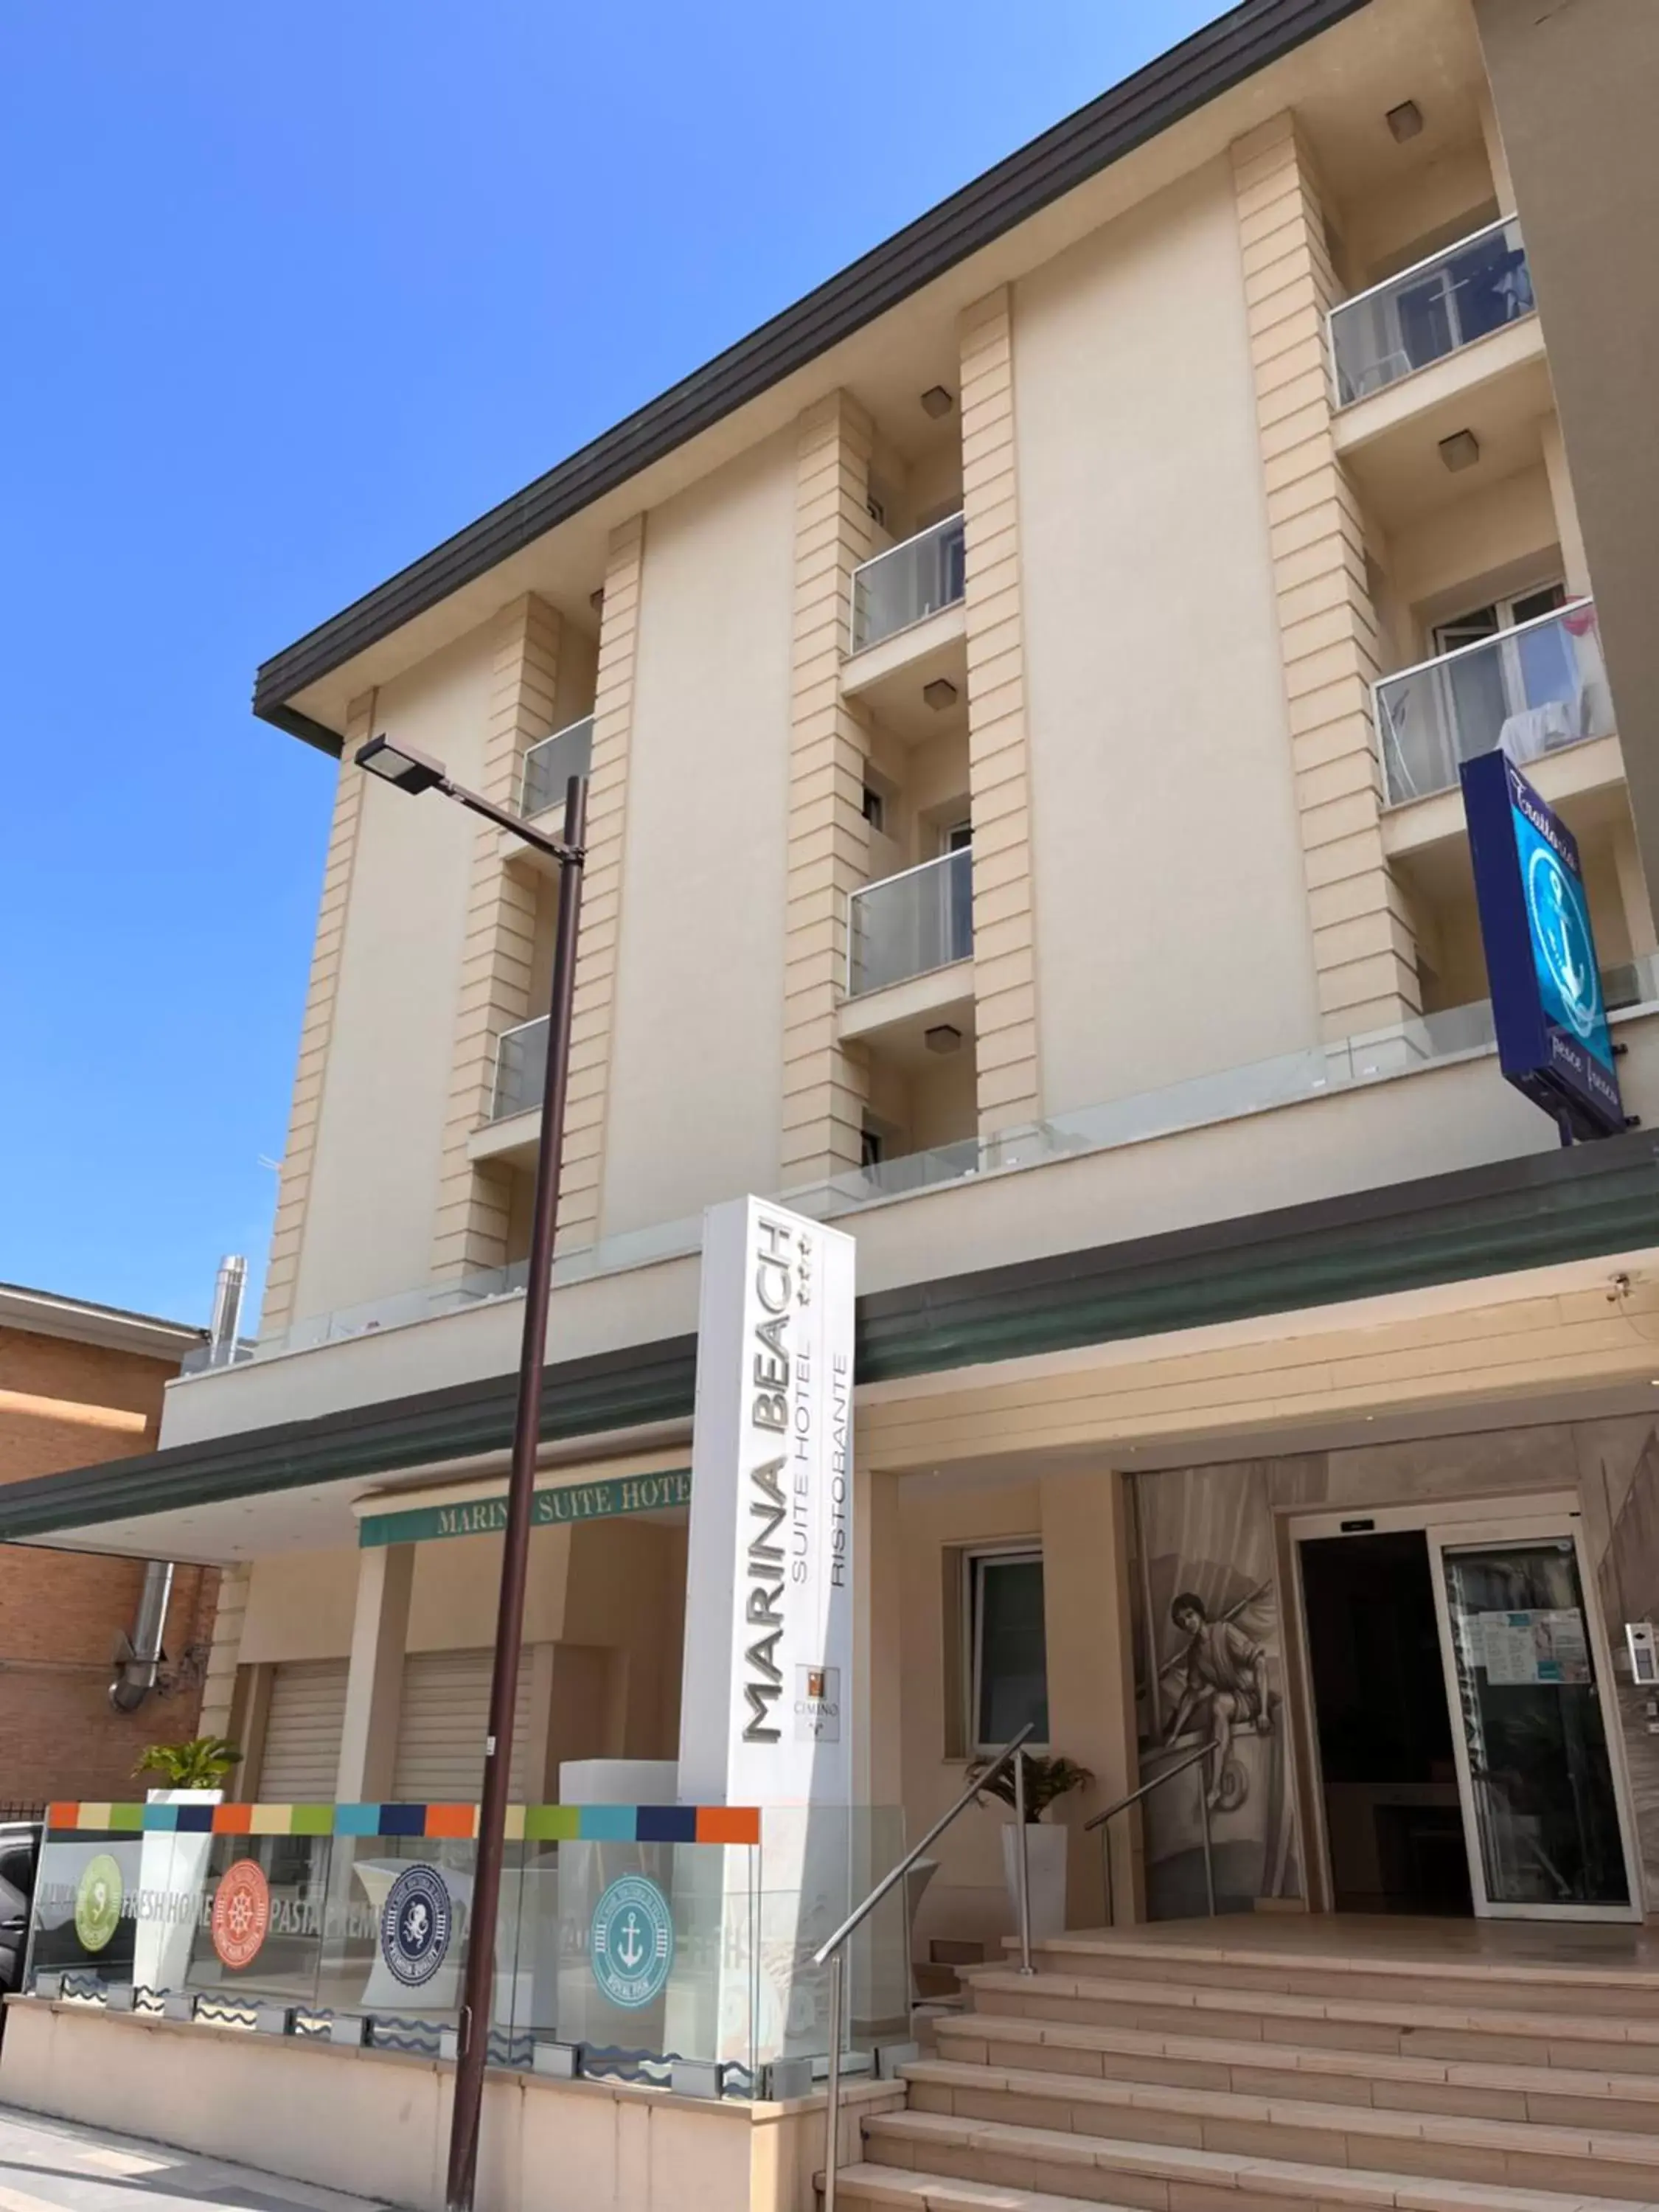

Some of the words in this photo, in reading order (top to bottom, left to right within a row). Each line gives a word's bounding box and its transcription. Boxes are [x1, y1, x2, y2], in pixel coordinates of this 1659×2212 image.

[1509, 768, 1577, 872] Trattoria
[1551, 1035, 1582, 1072] pesce
[754, 1217, 793, 1435] BEACH
[796, 1340, 811, 1462] HOTEL
[437, 1505, 508, 1534] MARIN
[538, 1486, 612, 1522] SUITE
[621, 1472, 692, 1509] HOTE
[831, 1353, 849, 1587] RISTORANTE
[792, 1474, 810, 1584] SUITE
[742, 1455, 786, 1744] MARINA
[270, 1900, 319, 1935] PASTA
